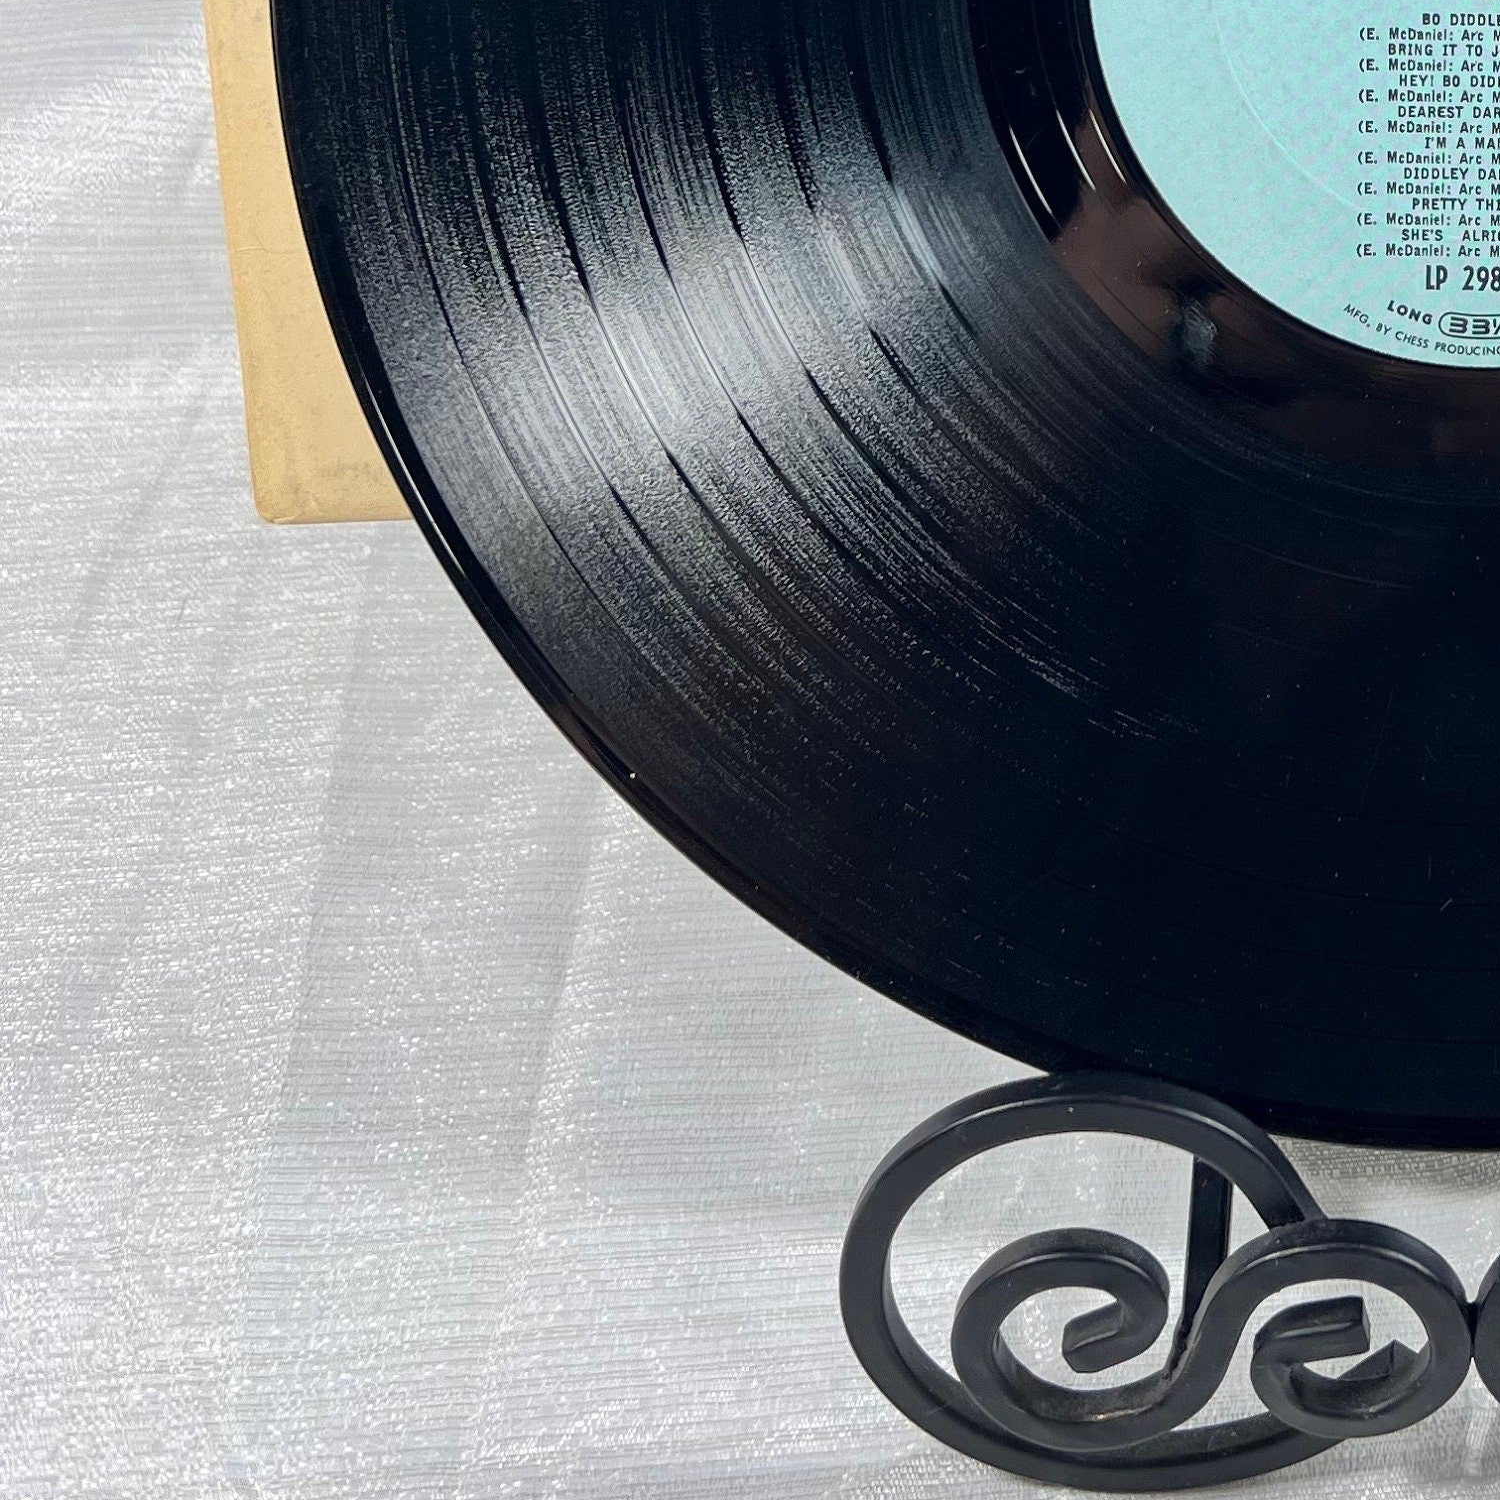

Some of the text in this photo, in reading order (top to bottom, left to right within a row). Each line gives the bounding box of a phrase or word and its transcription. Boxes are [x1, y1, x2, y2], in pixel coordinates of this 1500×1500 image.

[1422, 12, 1441, 26] BO
[1359, 26, 1380, 42] (E.
[1389, 26, 1454, 42] McDaniel:
[1460, 29, 1484, 42] Arc
[1388, 42, 1433, 57] BRING
[1442, 43, 1458, 57] IT
[1465, 43, 1483, 58] TO
[1358, 58, 1380, 73] (E.
[1388, 57, 1453, 72] McDaniel:
[1460, 59, 1484, 72] Arc
[1399, 73, 1434, 87] HEY!
[1442, 74, 1461, 88] BO
[1358, 88, 1379, 104] (E.
[1388, 88, 1453, 103] McDaniel:
[1459, 90, 1483, 103] Arc
[1397, 105, 1465, 119] DEAREST
[1358, 120, 1379, 134] (E.
[1387, 119, 1452, 134] McDaniel:
[1459, 121, 1483, 134] Arc
[1424, 136, 1447, 150] I'M
[1455, 136, 1466, 150] A
[1357, 151, 1378, 166] (E.
[1387, 150, 1452, 165] McDaniel:
[1459, 152, 1482, 165] Arc
[1403, 166, 1469, 181] DIDDLEY
[1357, 181, 1378, 196] (E.
[1386, 181, 1451, 195] McDaniel:
[1458, 182, 1482, 196] Arc
[1412, 196, 1468, 211] PRETTY
[1356, 212, 1377, 227] (E.
[1386, 212, 1451, 226] McDaniel:
[1457, 213, 1481, 227] Arc
[1401, 228, 1444, 242] SHE'S
[1356, 243, 1377, 258] (E.
[1385, 242, 1451, 258] McDaniel:
[1457, 244, 1481, 258] Arc
[1425, 264, 1448, 291] LP
[1387, 300, 1433, 325] LONG
[1343, 304, 1371, 328] MFG.
[1375, 322, 1392, 336] BY
[1395, 331, 1430, 349] CHESS
